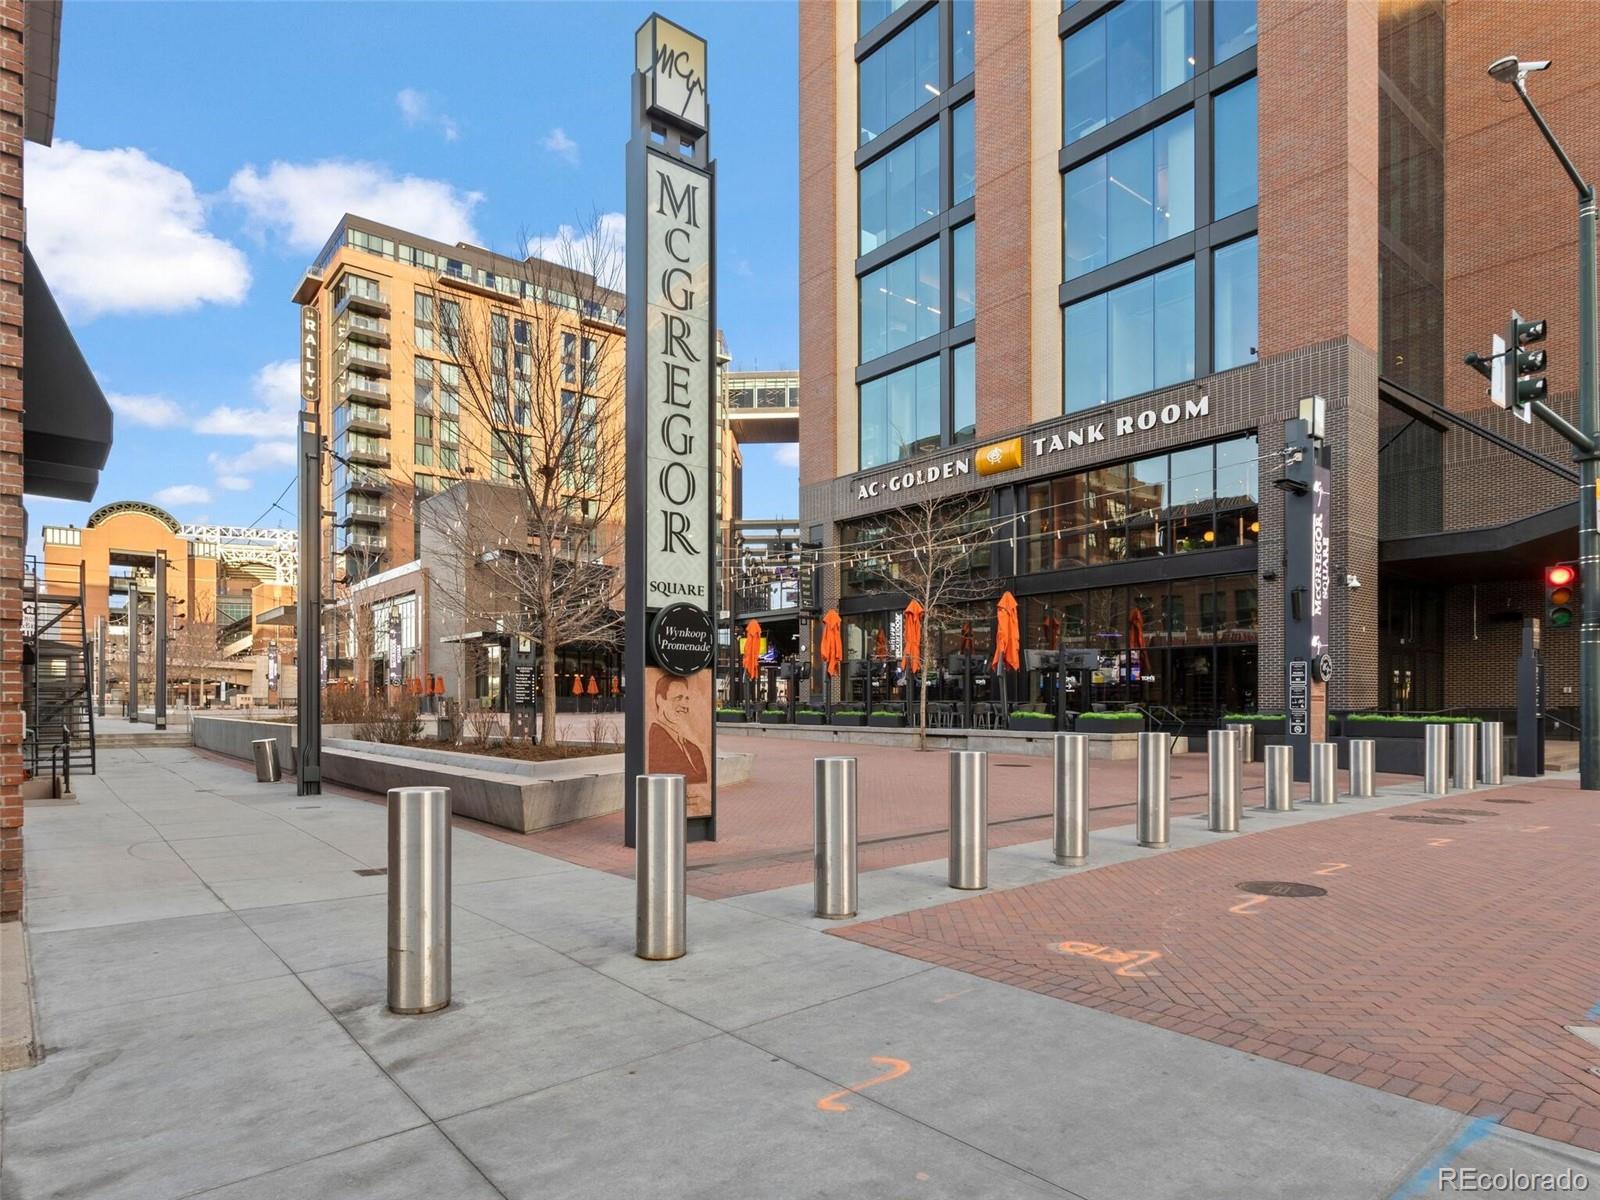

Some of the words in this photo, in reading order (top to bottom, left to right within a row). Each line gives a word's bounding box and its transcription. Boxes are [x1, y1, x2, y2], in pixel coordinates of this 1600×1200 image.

[304, 318, 317, 388] RALLY
[656, 169, 701, 556] MCGREGOR
[1032, 422, 1105, 456] TANK
[1116, 395, 1209, 437] ROOM
[649, 580, 705, 597] SQUARE
[1322, 536, 1330, 600] SQUARE
[661, 639, 711, 652] Promenade
[665, 626, 707, 642] Wynkoop
